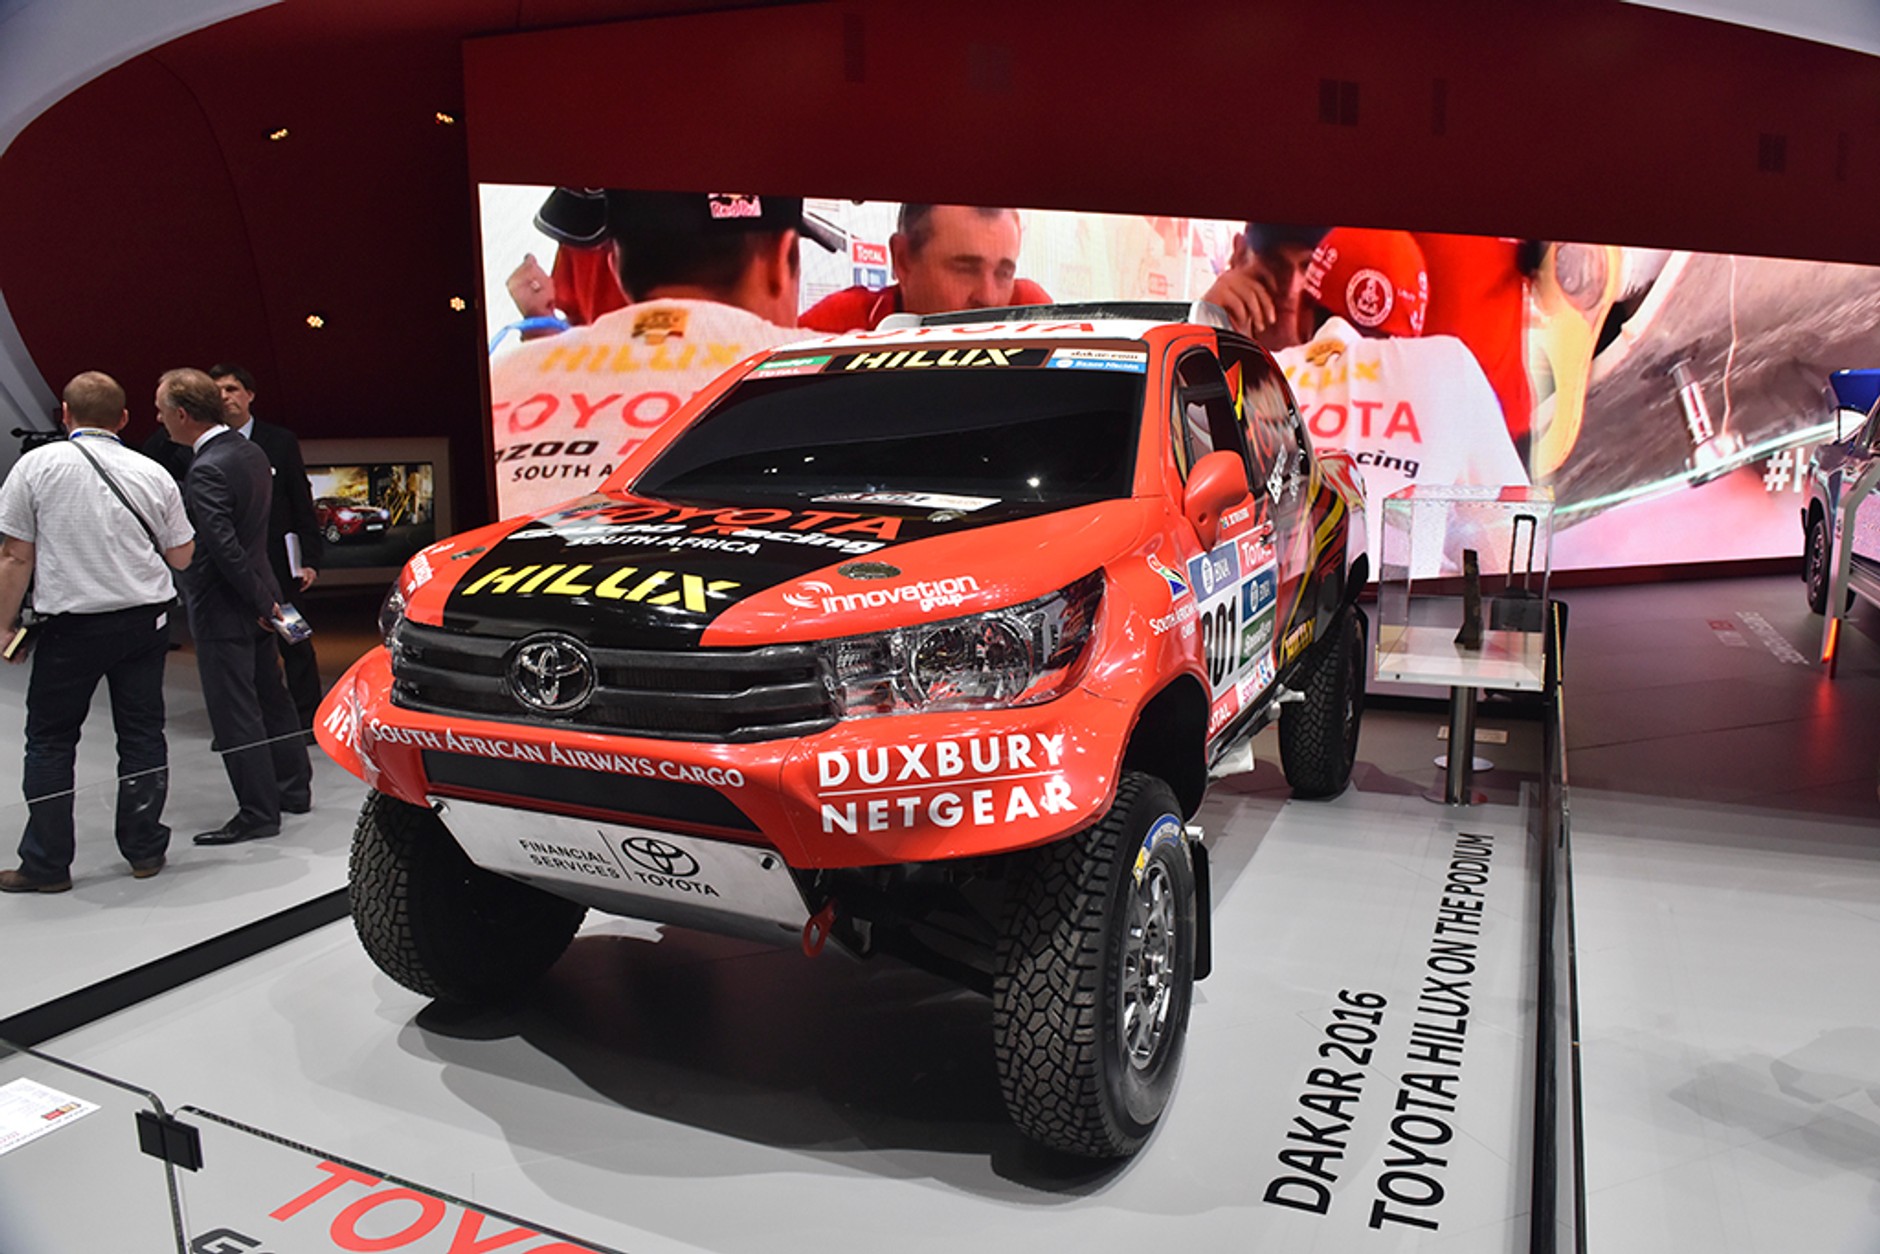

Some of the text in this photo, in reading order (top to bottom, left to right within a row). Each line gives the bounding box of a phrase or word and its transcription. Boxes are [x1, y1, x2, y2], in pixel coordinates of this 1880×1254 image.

[1300, 400, 1423, 444] OTA
[512, 464, 590, 482] SOUTH
[662, 536, 762, 555] AFRICA
[461, 564, 742, 613] HILUX
[821, 575, 980, 614] innovation
[368, 717, 746, 788] SOUTH AFRICAN AIRWAYS CARGO
[817, 733, 1065, 788] DUXBURY
[821, 774, 1078, 835] NETGEAR
[519, 839, 613, 865] FINANCIAL
[529, 854, 621, 879] SERVICES
[634, 871, 720, 898] TOYOTA
[1368, 832, 1495, 1231] TOYOTA HILUX ON THE PODIUM
[1262, 988, 1388, 1215] DAKAR 2016
